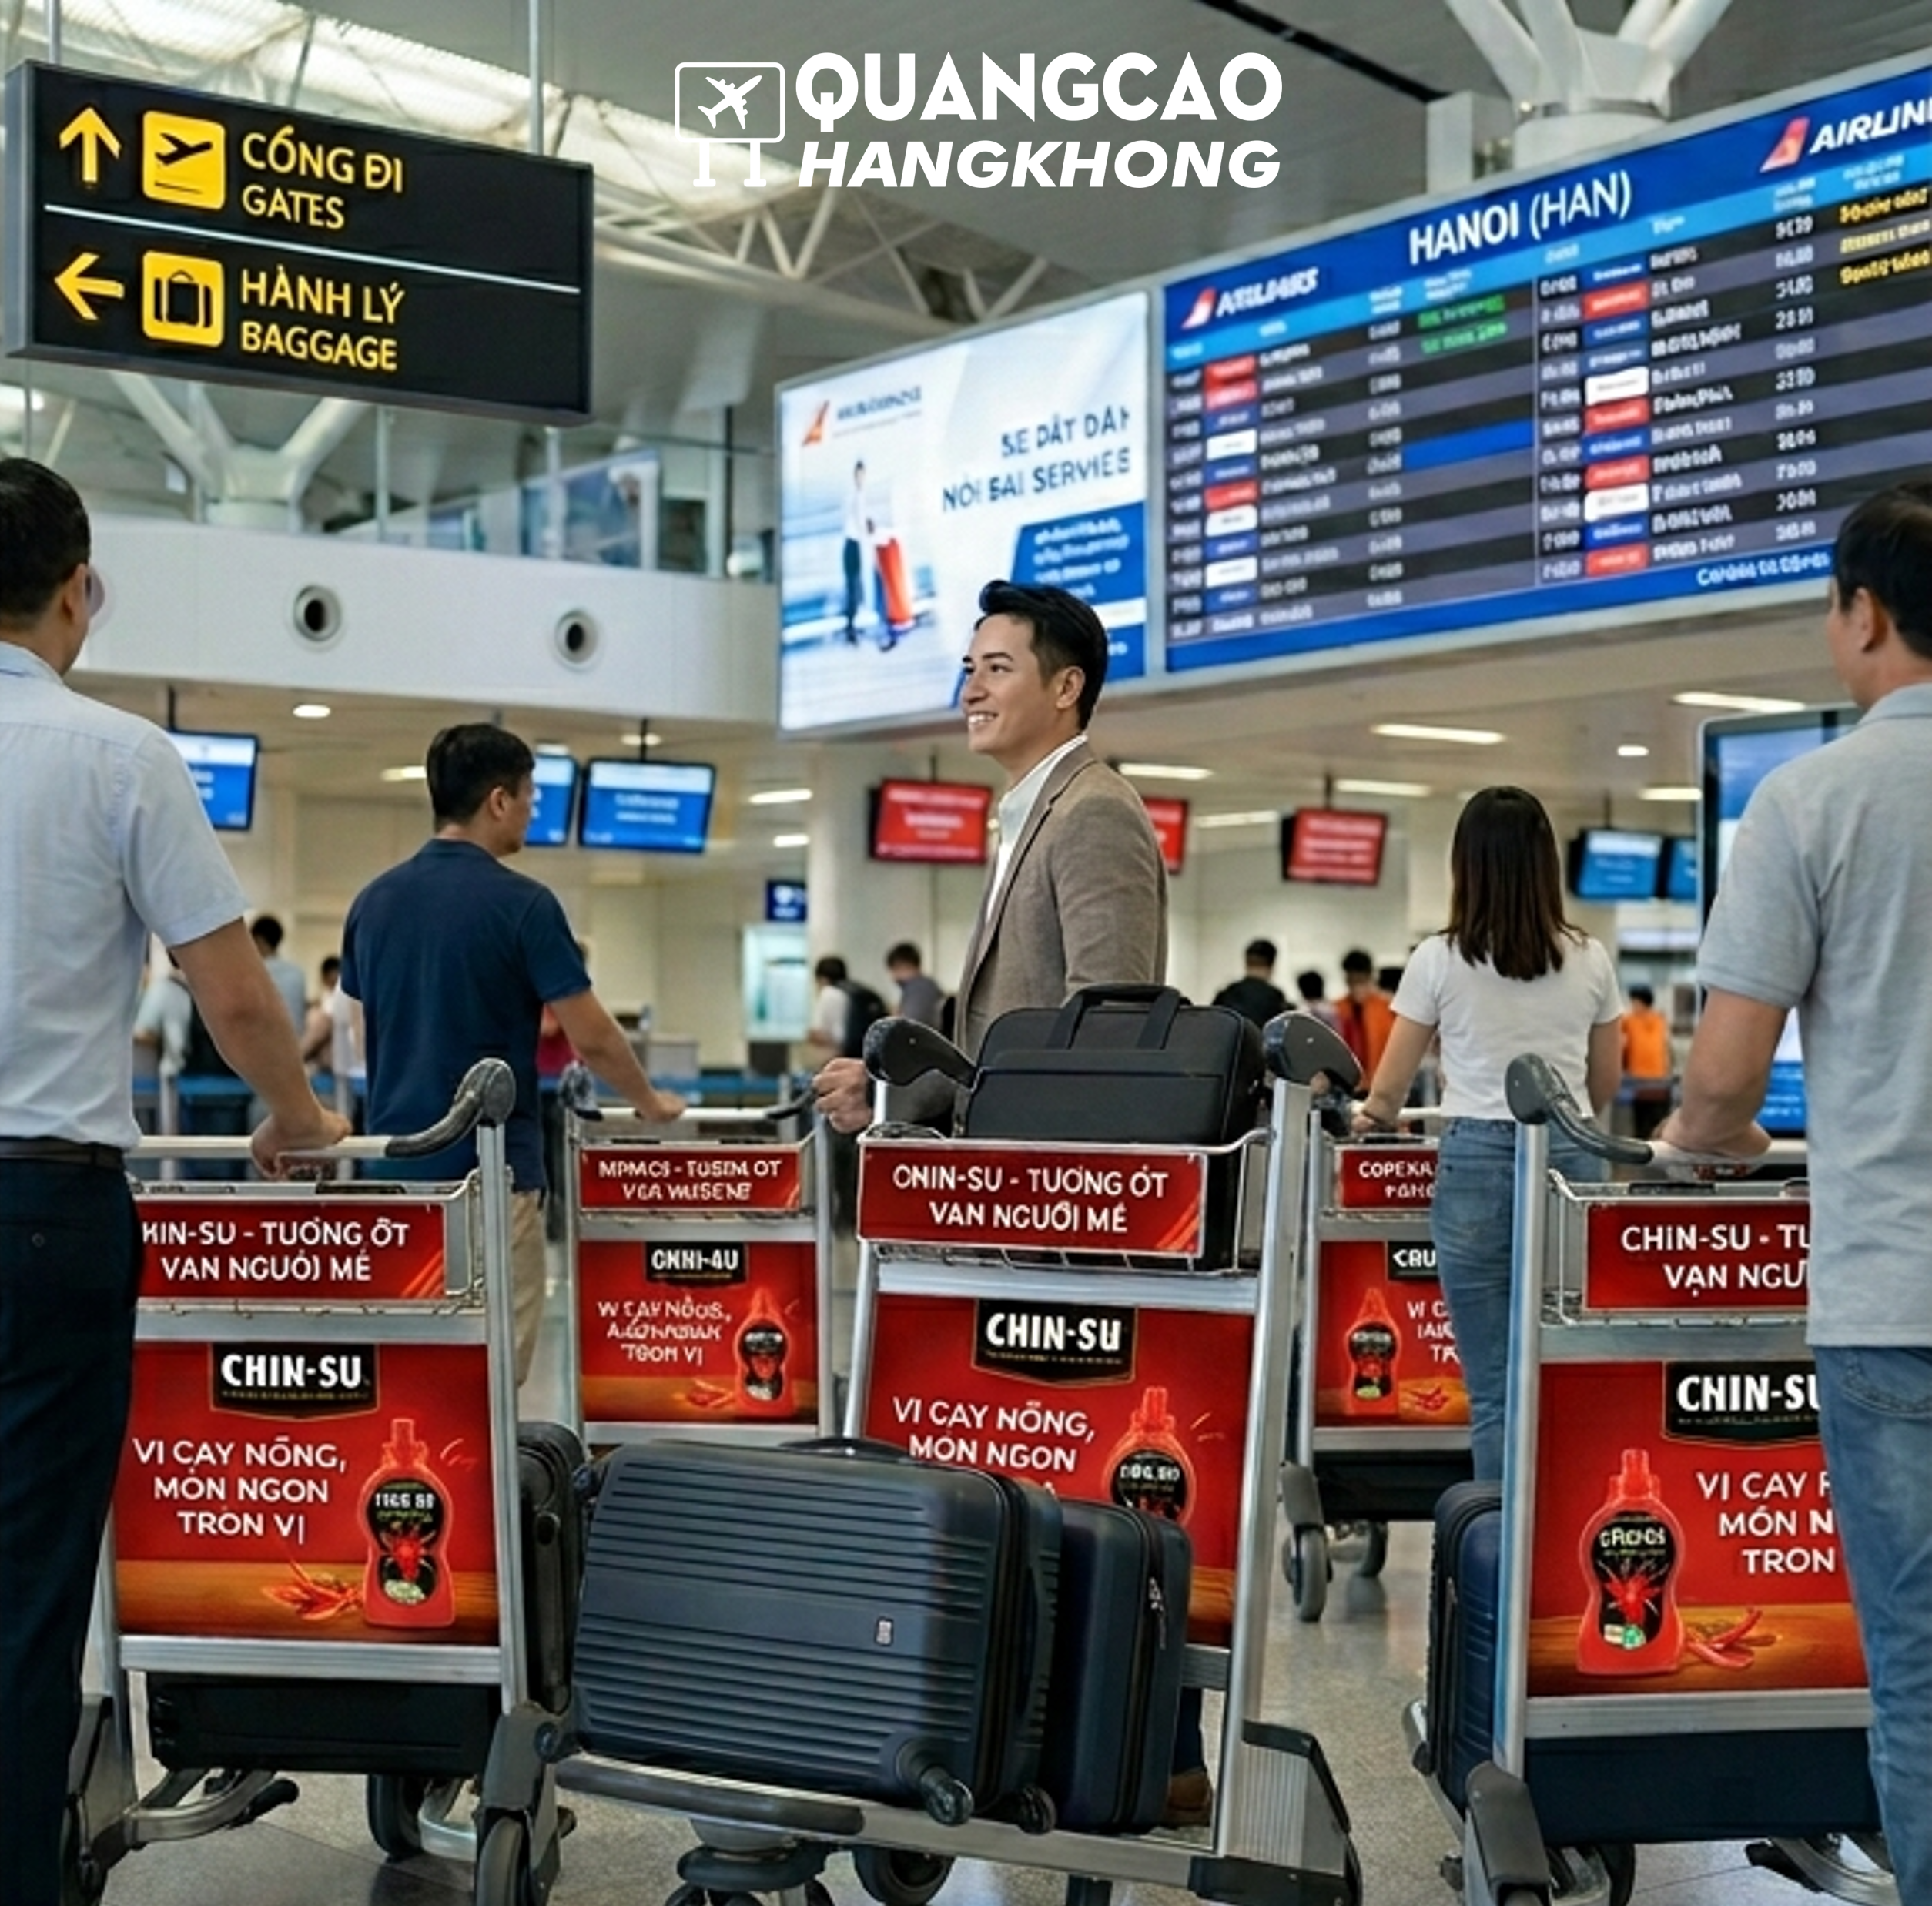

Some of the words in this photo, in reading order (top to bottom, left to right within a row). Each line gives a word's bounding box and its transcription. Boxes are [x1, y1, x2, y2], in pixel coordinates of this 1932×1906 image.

[365, 153, 403, 193] ĐI
[242, 185, 345, 229] GATES
[1409, 200, 1519, 266] HANOI
[1529, 169, 1632, 240] (HAN)
[241, 263, 350, 318] HÀNH
[363, 281, 406, 323] LÝ
[241, 320, 398, 371] BAGGAGE
[1620, 1224, 1751, 1251] CHIN-SU
[1662, 1263, 1729, 1298] VẠN
[986, 1312, 1122, 1352] CHIN-SU
[221, 1354, 362, 1388] CHIN-SU
[929, 1400, 989, 1429] CAY
[172, 1439, 234, 1465] CAY
[986, 1440, 1077, 1473] NGON
[236, 1477, 328, 1503] NGON
[1696, 1472, 1730, 1501] VI
[1741, 1472, 1809, 1499] CAY
[1719, 1504, 1798, 1537] MÓN
[1741, 1546, 1836, 1574] TRON
